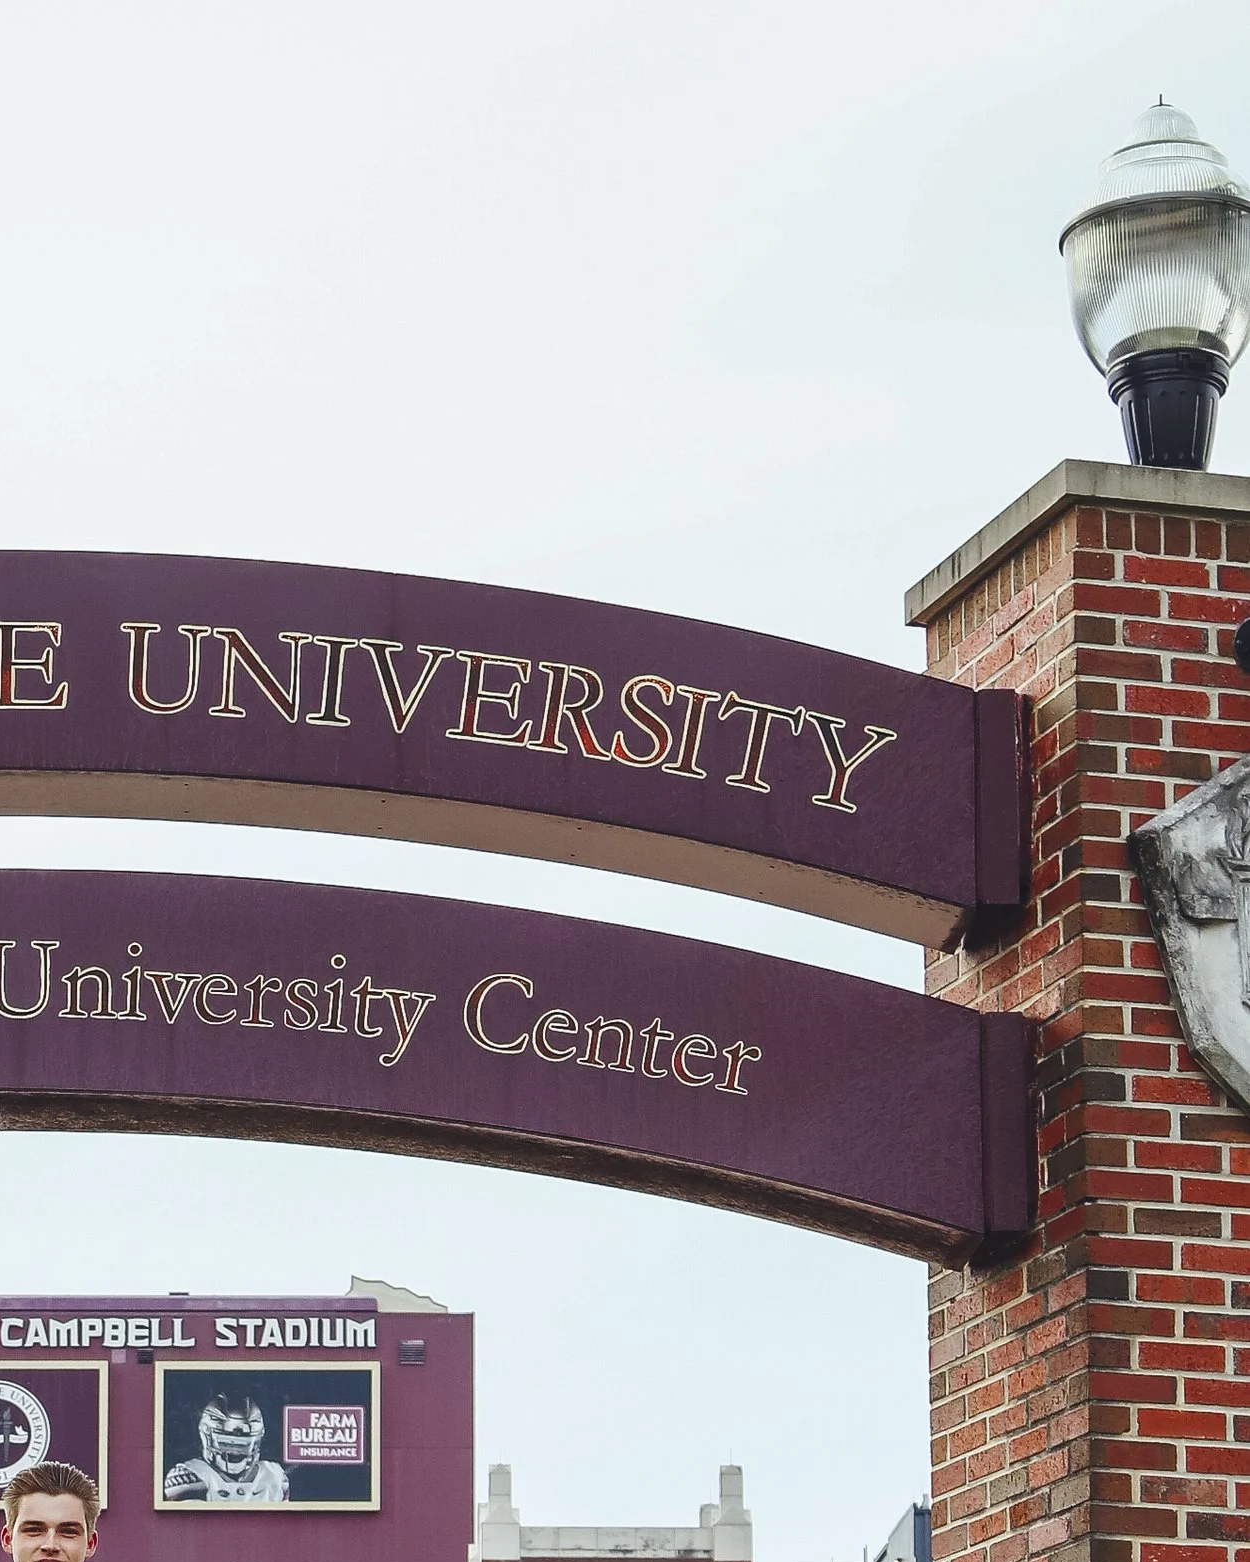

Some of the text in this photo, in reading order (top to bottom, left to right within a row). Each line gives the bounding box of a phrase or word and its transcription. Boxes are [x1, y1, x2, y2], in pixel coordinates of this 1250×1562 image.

[119, 621, 898, 813] UNIVERSITY
[463, 973, 762, 1096] Center
[0, 1317, 196, 1348] CAMPBELL
[214, 1317, 377, 1348] STADIUM
[10, 1390, 43, 1463] UNIVERSITY
[291, 1428, 358, 1443] BUREAU
[310, 1412, 357, 1428] FARM
[300, 1447, 357, 1457] INSURANCE
